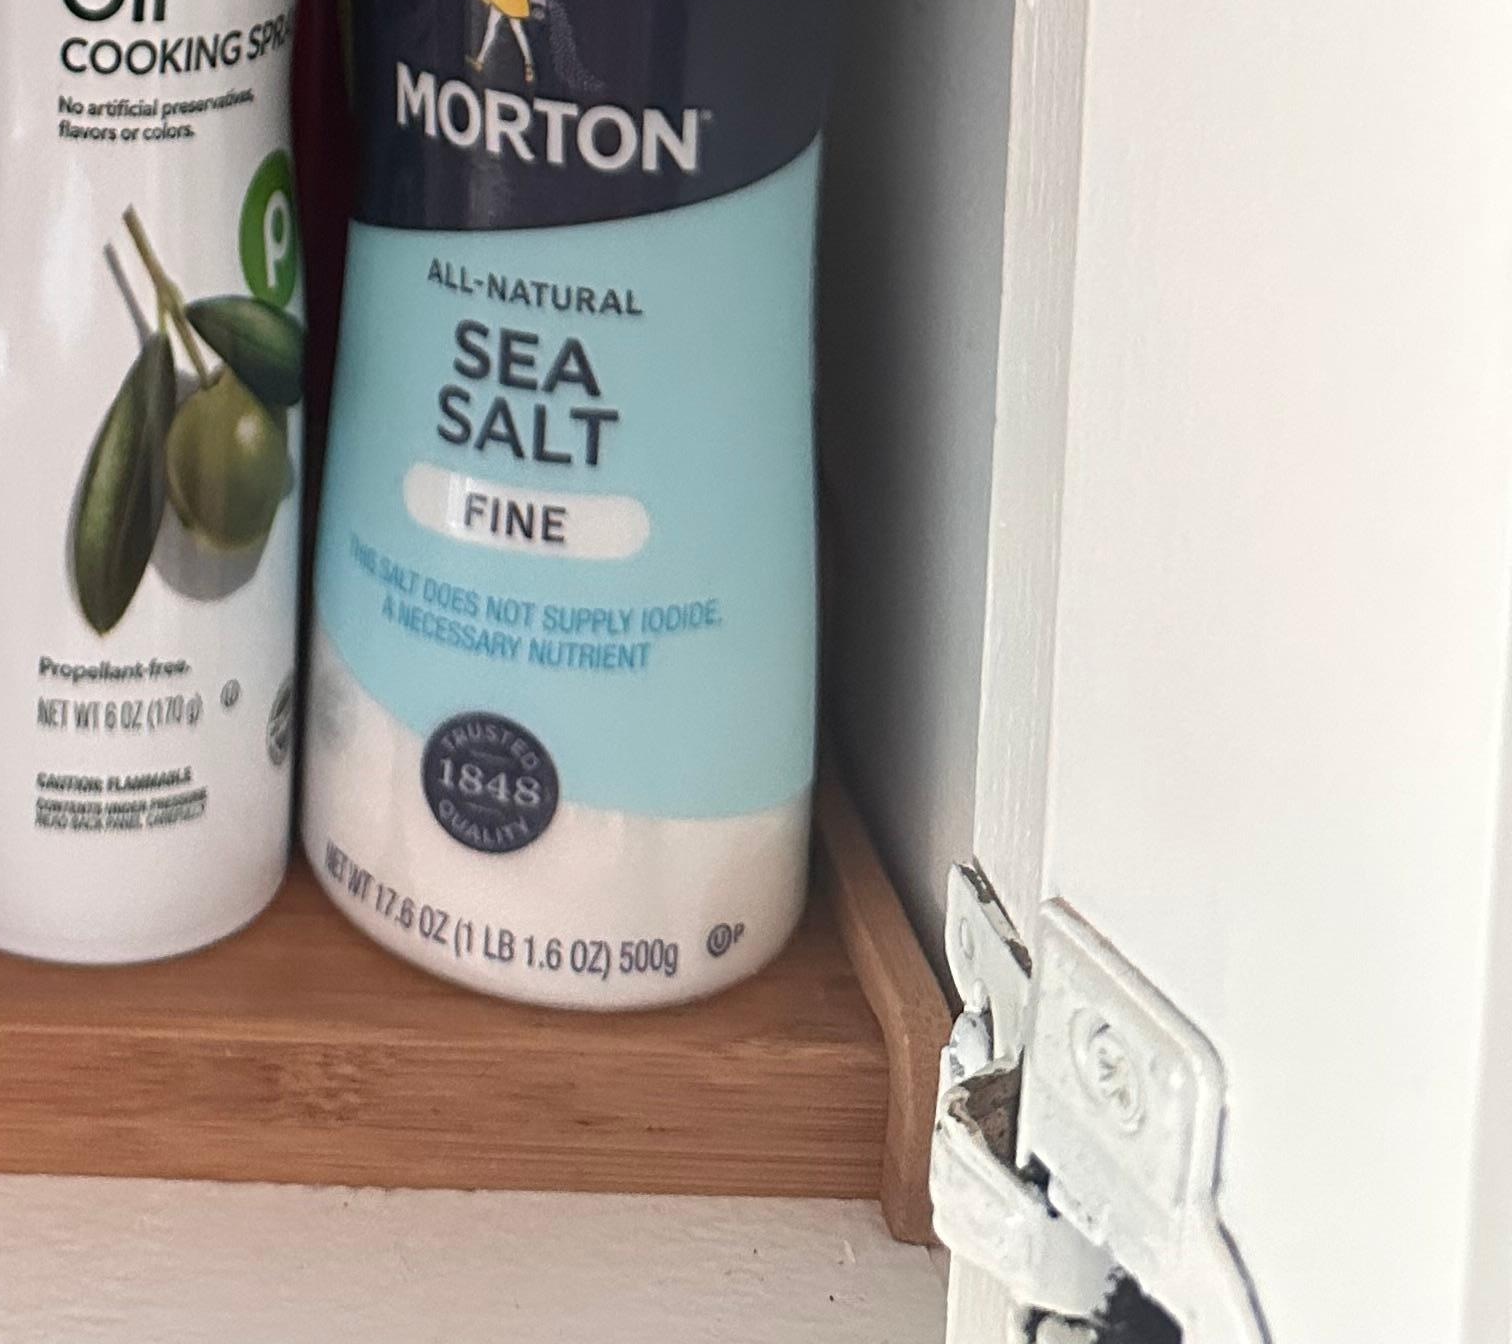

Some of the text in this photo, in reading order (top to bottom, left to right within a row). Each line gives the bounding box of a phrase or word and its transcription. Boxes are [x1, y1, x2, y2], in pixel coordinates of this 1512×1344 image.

[61, 14, 290, 74] COOKING SPR
[58, 94, 84, 115] No
[88, 96, 158, 118] artificial
[58, 119, 116, 141] flavors
[120, 124, 139, 141] or
[395, 60, 700, 172] MORTON
[427, 257, 643, 316] ALL-NATURAL
[453, 318, 602, 398] SEA
[437, 384, 620, 466] SALT
[463, 493, 567, 543] FINE
[379, 558, 420, 594] SALT
[423, 577, 478, 614] DOES
[486, 595, 537, 627] NOT
[543, 603, 633, 635] SUPPLY
[382, 595, 651, 669] A NECESSARY NUTRIENT
[38, 696, 68, 728] NET
[73, 698, 99, 731] WT
[104, 700, 118, 731] 6
[120, 699, 143, 731] OZ
[442, 721, 540, 771] TRUSTED
[438, 757, 542, 808] 1848
[438, 798, 531, 845] QUALITY
[325, 841, 679, 980] NET WT 17.6 OZ (1 LB 1.6 OZ) 500g
